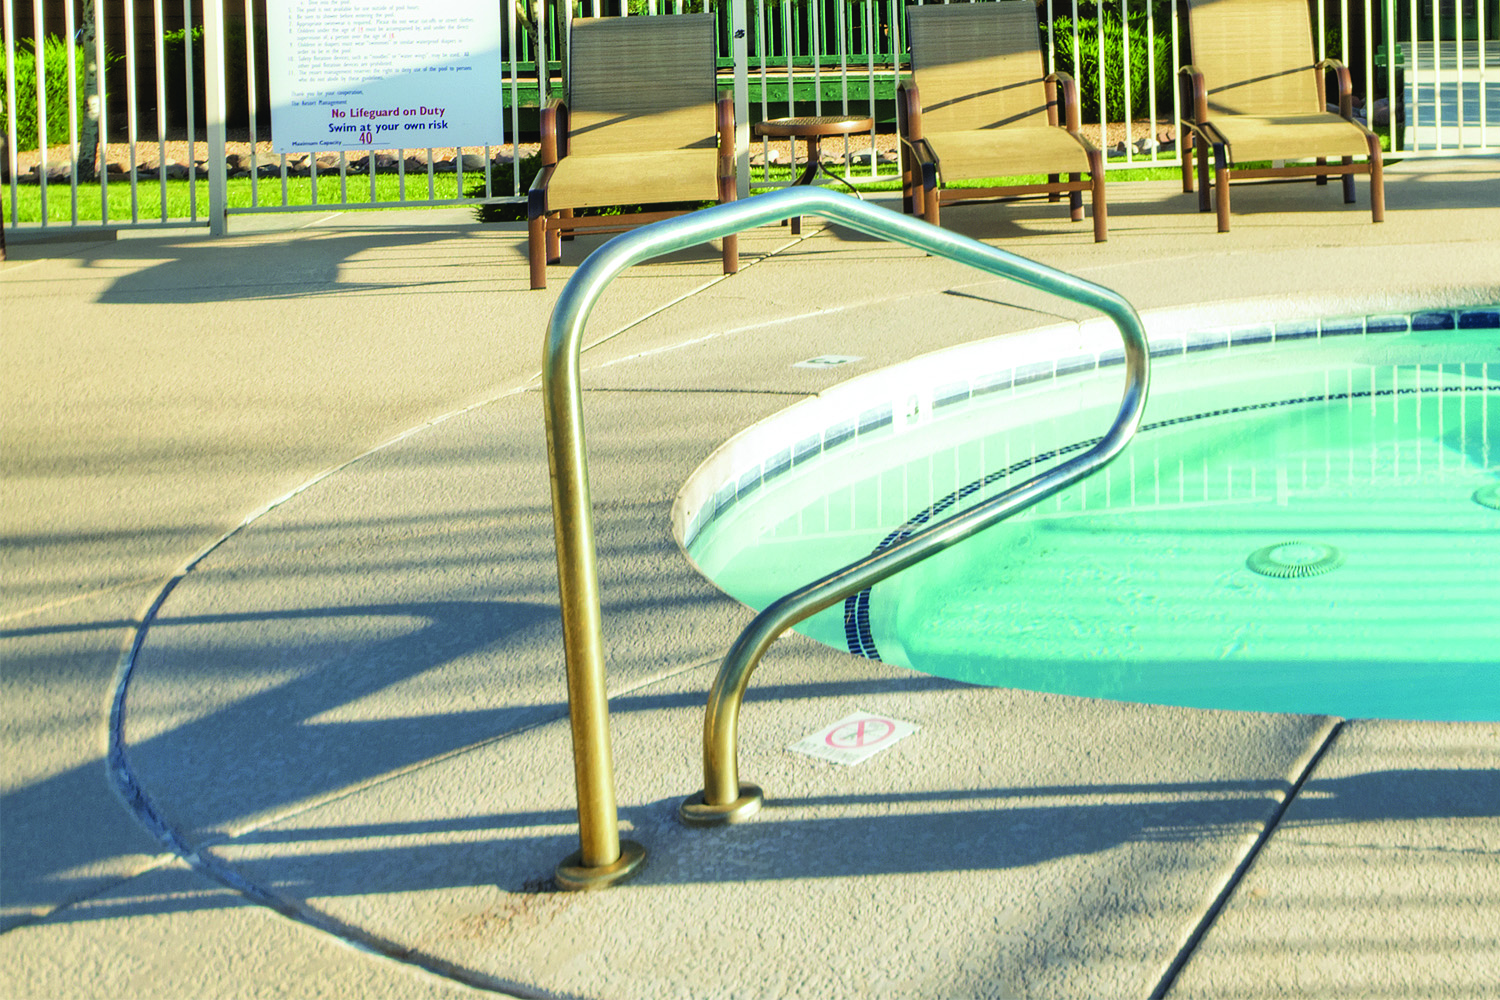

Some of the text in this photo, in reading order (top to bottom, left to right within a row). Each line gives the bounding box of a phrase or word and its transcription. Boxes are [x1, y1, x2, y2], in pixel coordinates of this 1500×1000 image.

[331, 108, 346, 118] No
[350, 107, 399, 120] Lifeguard
[420, 106, 445, 117] Duty
[328, 123, 357, 132] Swim
[360, 123, 371, 131] at
[375, 123, 399, 134] your
[428, 120, 448, 129] risk
[359, 132, 373, 144] 40
